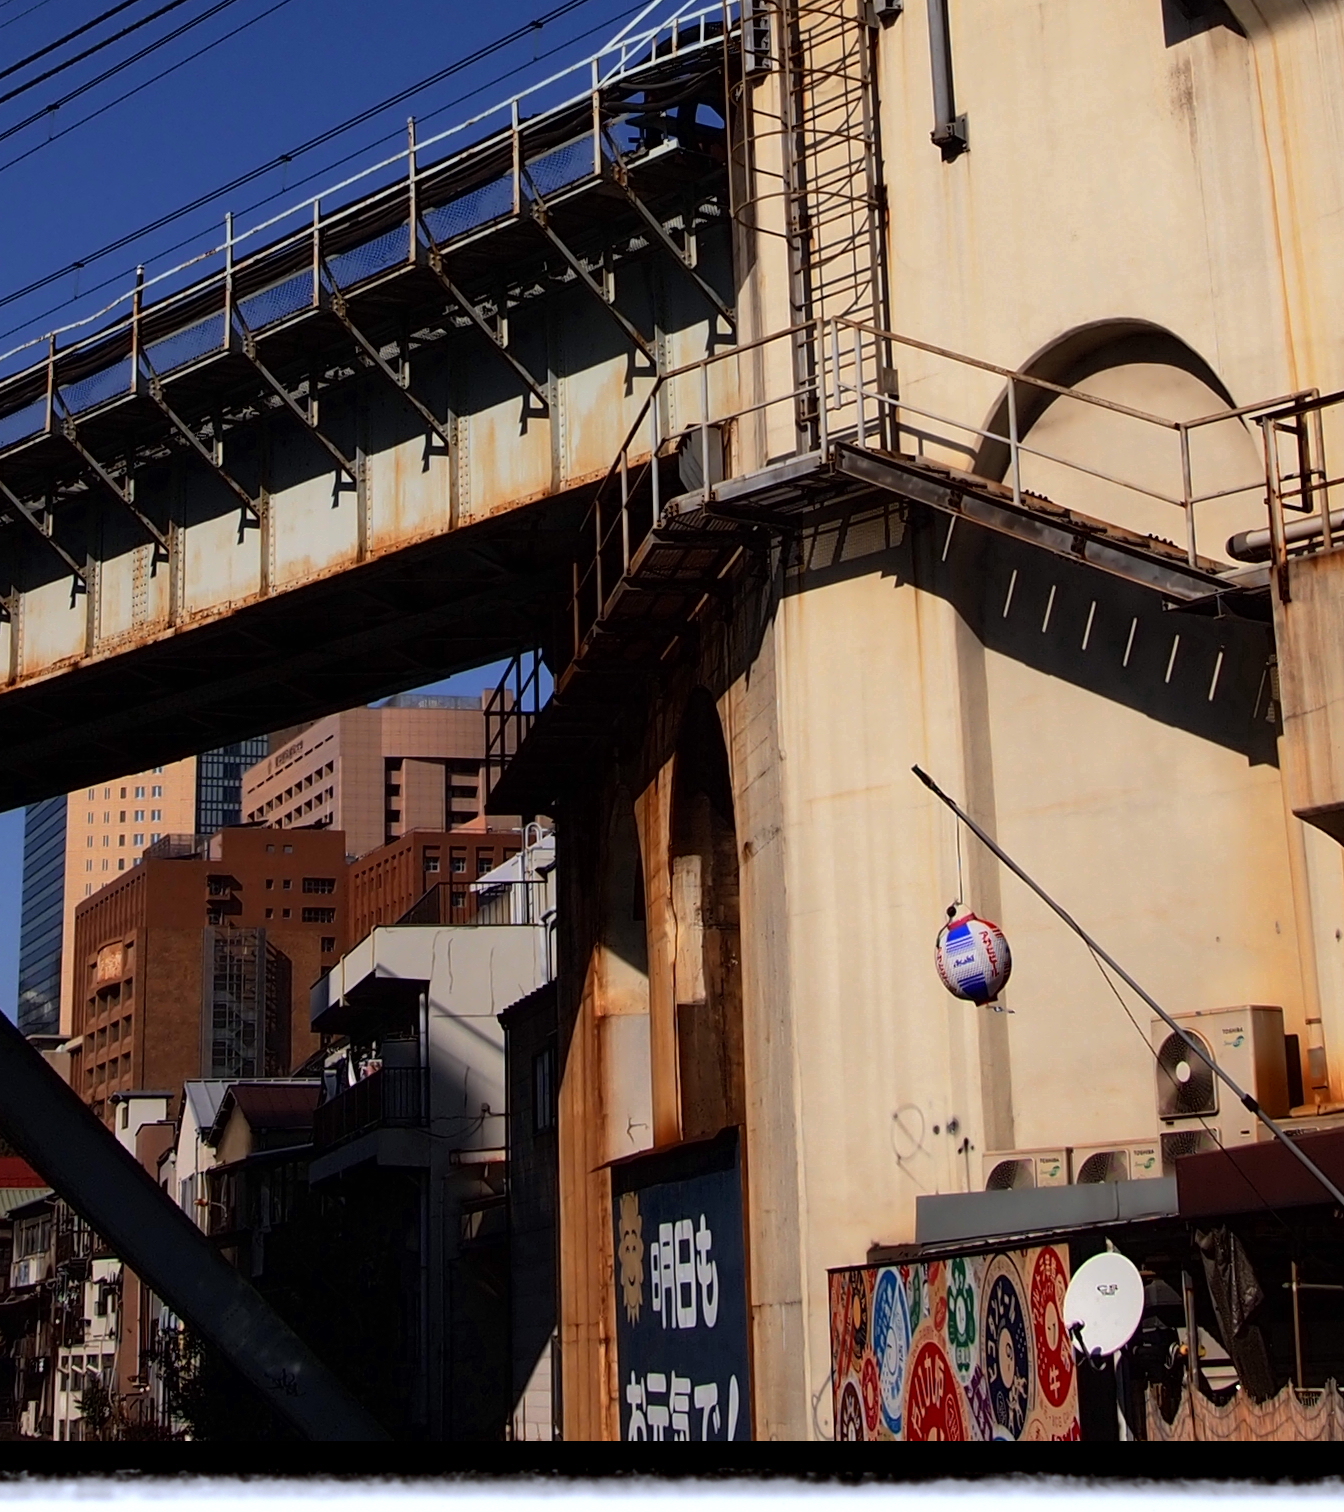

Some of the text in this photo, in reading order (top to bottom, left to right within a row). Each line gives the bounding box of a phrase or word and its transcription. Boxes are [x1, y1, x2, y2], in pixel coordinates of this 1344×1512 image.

[953, 954, 975, 968] Asahi
[650, 1213, 719, 1330] 明日も
